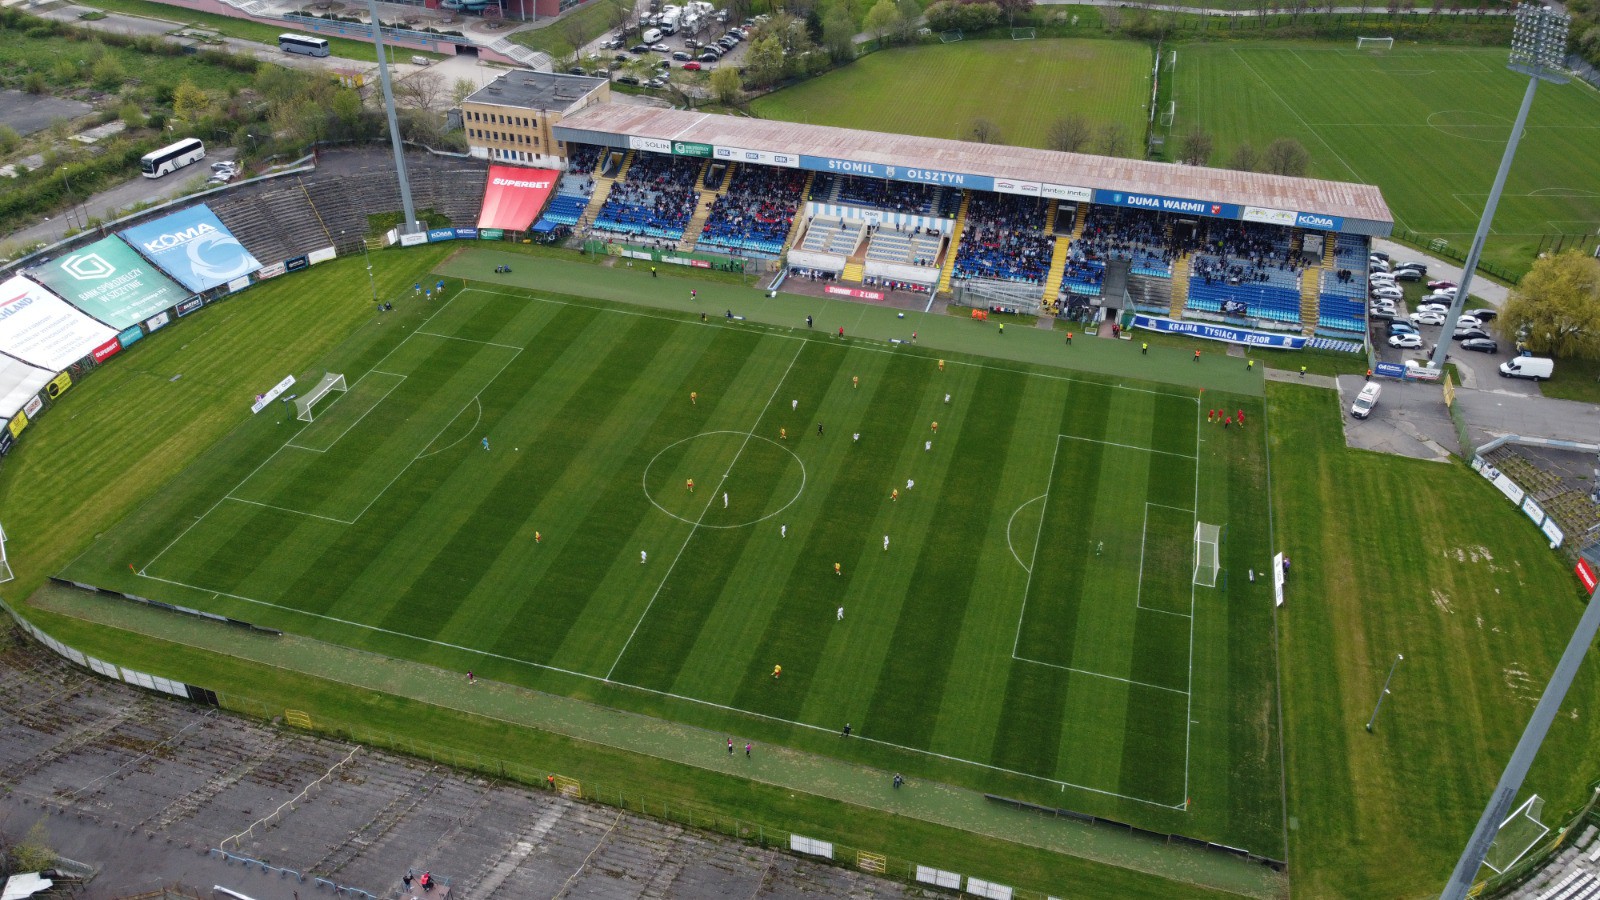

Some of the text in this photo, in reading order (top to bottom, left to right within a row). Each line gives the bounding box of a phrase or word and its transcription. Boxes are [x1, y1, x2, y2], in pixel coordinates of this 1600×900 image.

[645, 141, 670, 150] SOLIN
[828, 160, 964, 184] STOMIL OLSZTYN
[493, 177, 550, 189] SUPERBET
[1127, 195, 1205, 213] DUMA WARMII
[1298, 215, 1334, 226] KOMA
[144, 223, 216, 252] KOMA
[78, 288, 101, 301] BANK
[98, 294, 111, 303] W
[1168, 322, 1198, 333] KRAINA
[1243, 334, 1270, 344] JEZIOR
